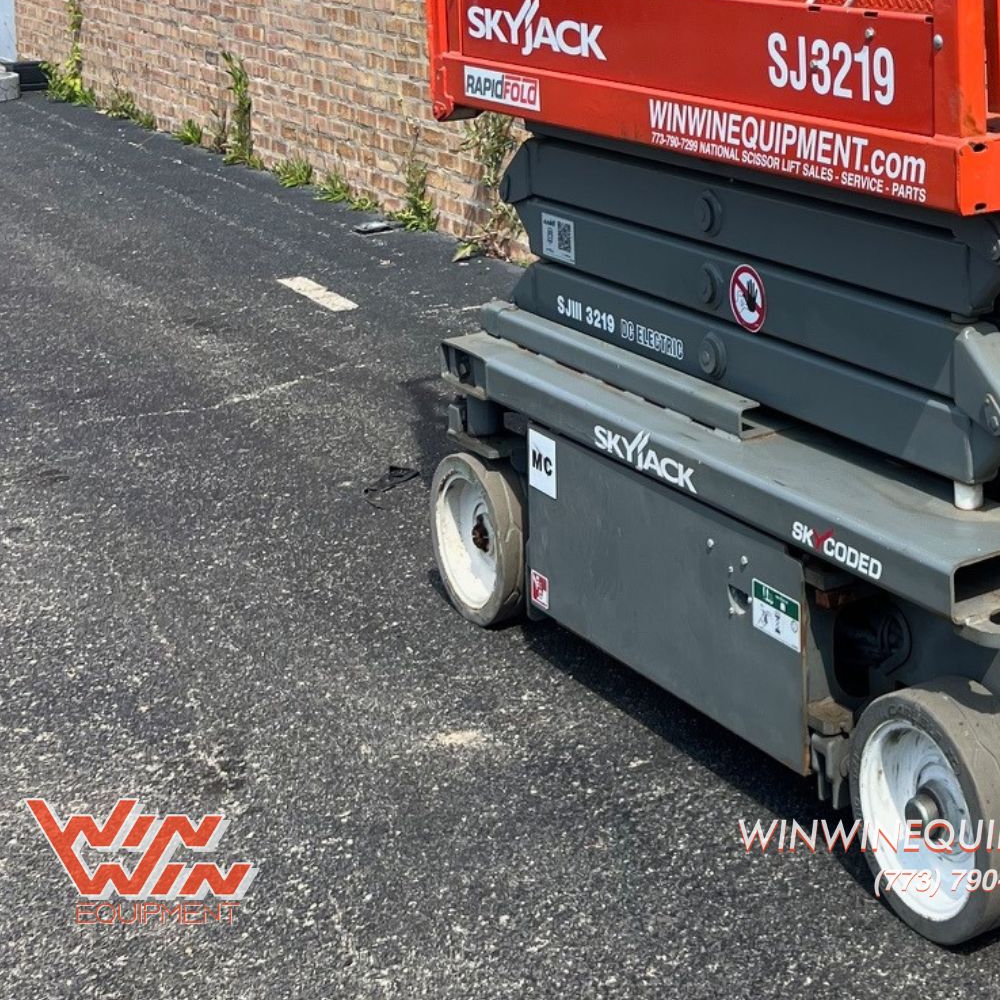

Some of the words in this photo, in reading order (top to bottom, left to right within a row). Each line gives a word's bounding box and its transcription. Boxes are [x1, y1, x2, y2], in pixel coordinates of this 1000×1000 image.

[767, 31, 895, 106] SJ3219
[649, 98, 926, 184] WINWINEQUIPMENT.com
[651, 131, 698, 152] 773-790-7299
[699, 141, 740, 163] NATIONAL
[741, 149, 779, 170] SCISSOR
[781, 158, 801, 174] LIFT
[802, 163, 833, 182] SALES
[840, 170, 883, 194] SERVICE
[891, 183, 927, 203] PARTS
[586, 306, 615, 333] 3219
[620, 318, 634, 341] DC
[636, 324, 684, 361] ELECTRIC
[531, 449, 553, 477] MC
[594, 425, 697, 494] SKYJACK
[791, 521, 882, 580] SKYCODED
